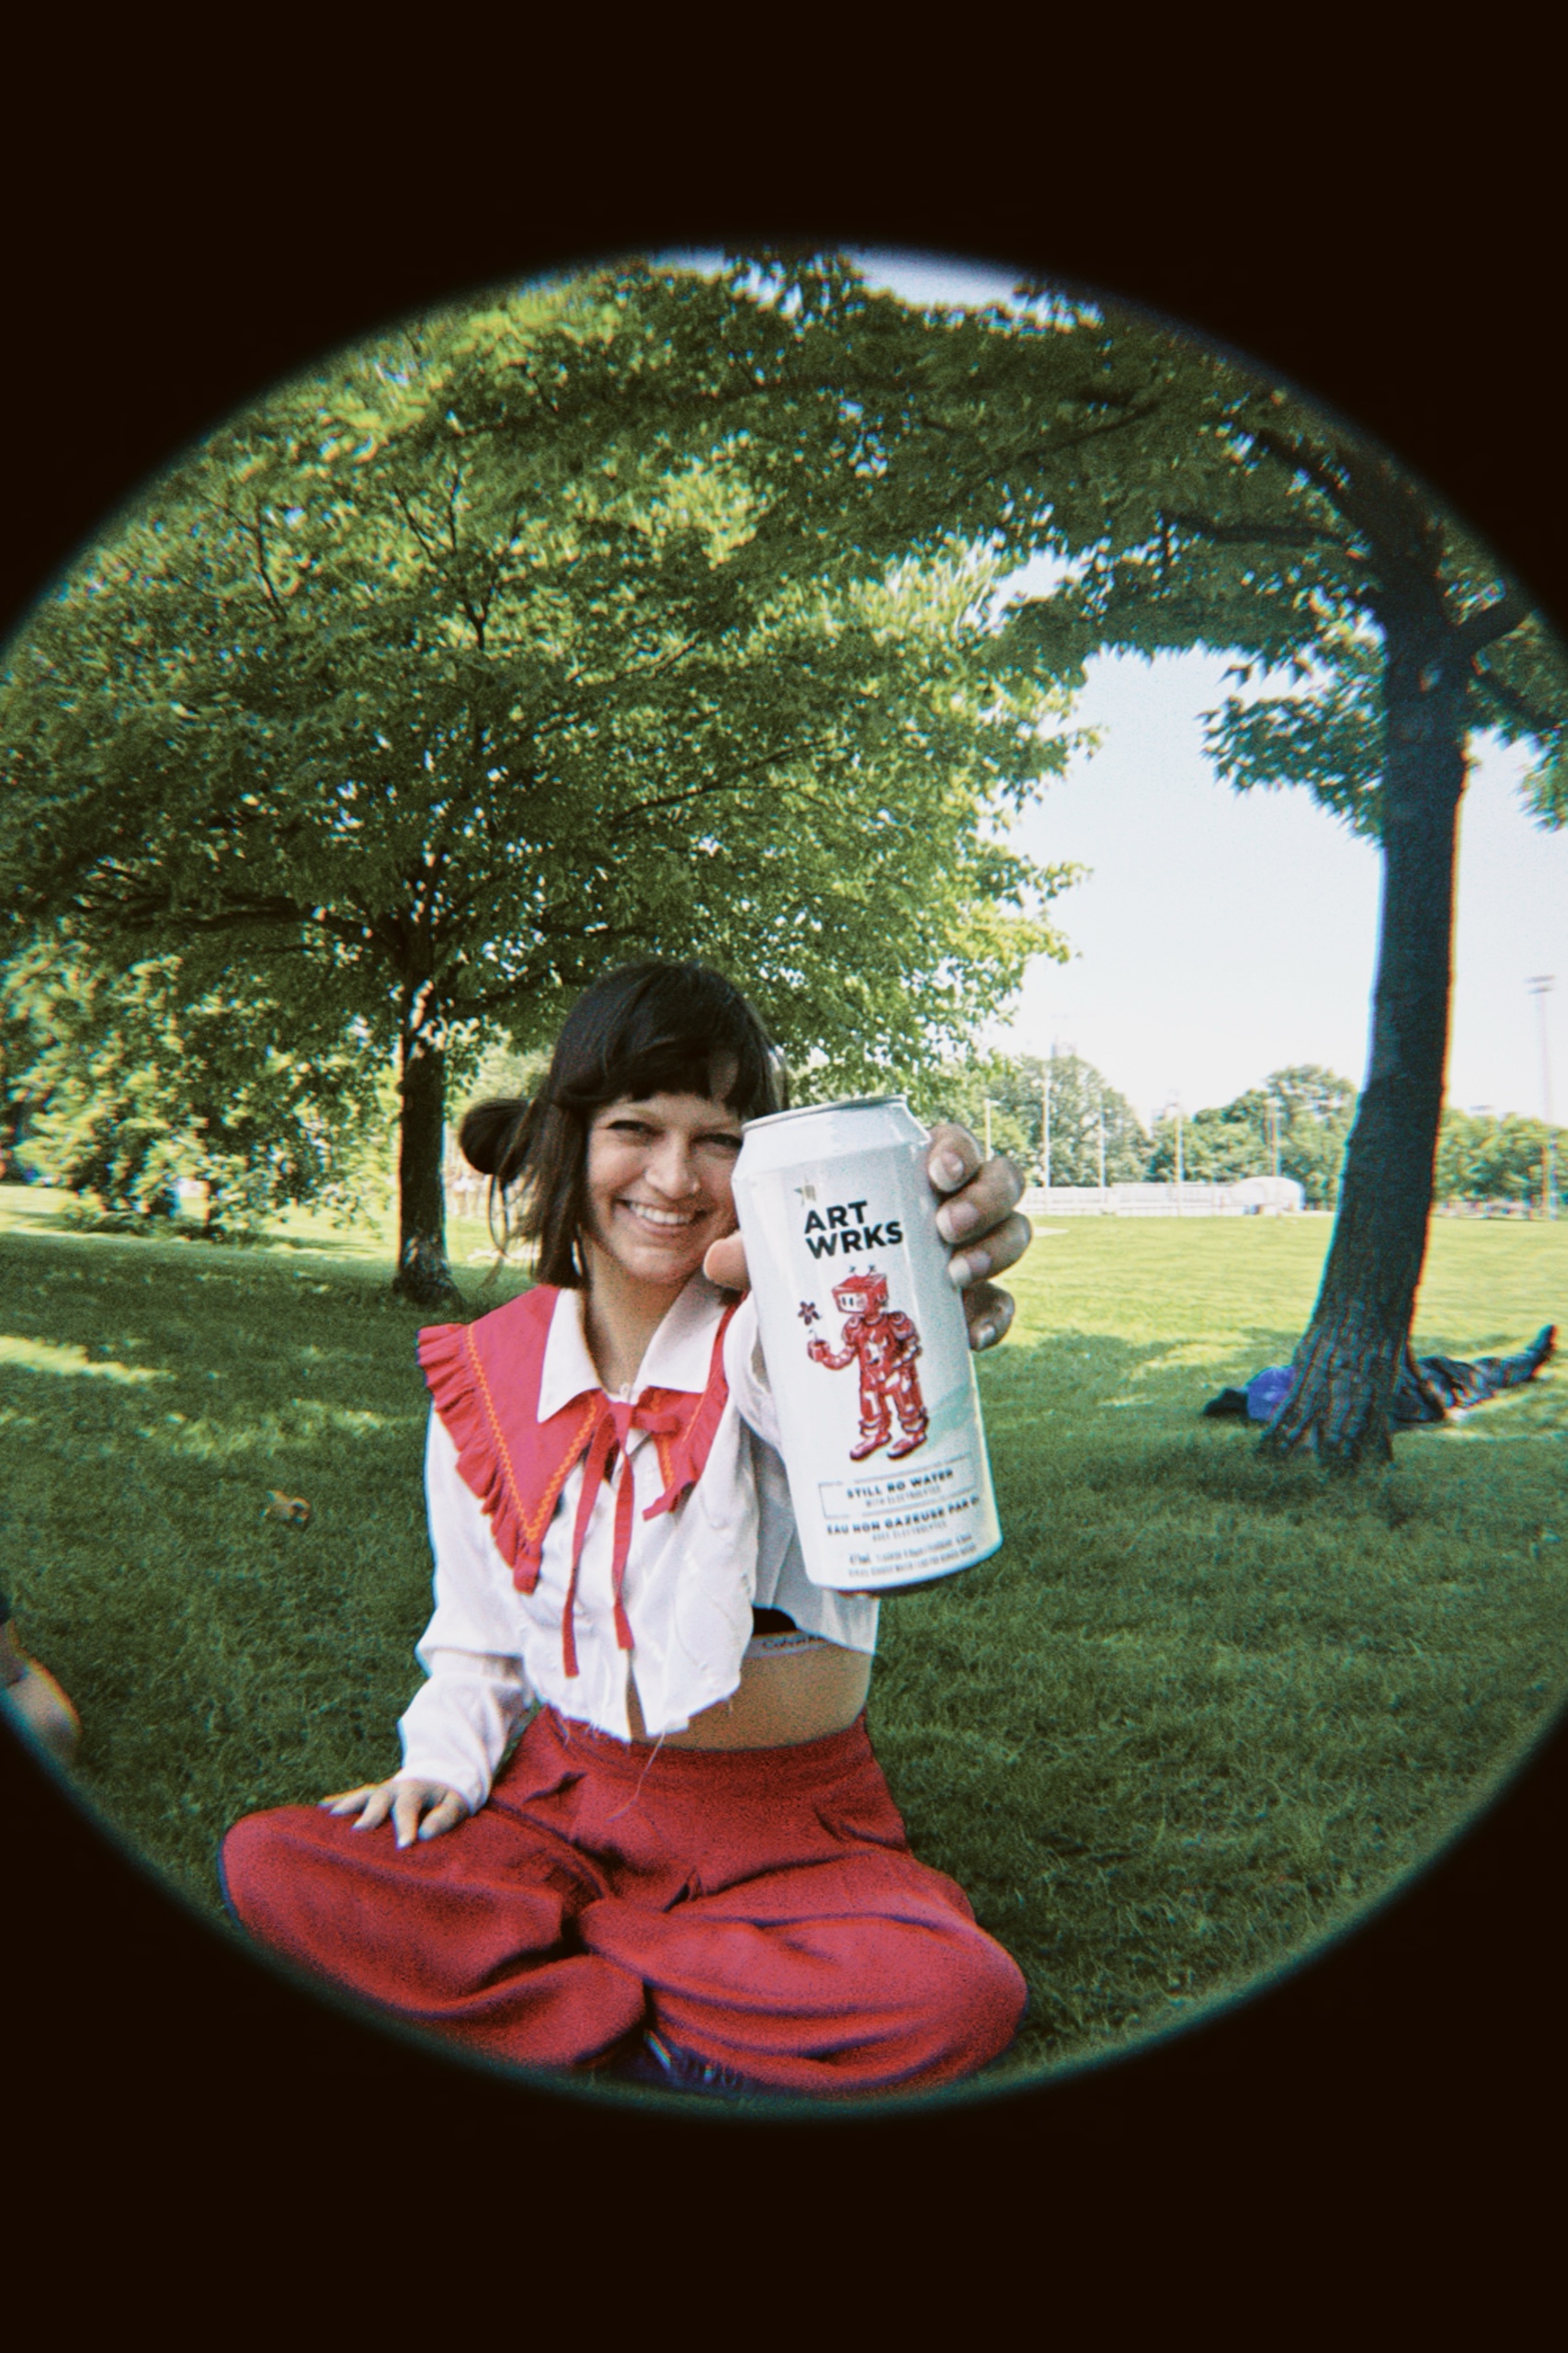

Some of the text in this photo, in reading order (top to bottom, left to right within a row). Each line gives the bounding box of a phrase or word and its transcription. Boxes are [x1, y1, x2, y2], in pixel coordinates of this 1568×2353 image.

[804, 1199, 869, 1234] ART
[805, 1221, 904, 1260] WRKS
[846, 1468, 954, 1499] STILL RO WATER
[826, 1524, 849, 1536] EAU
[853, 1520, 881, 1534] NON
[885, 1506, 945, 1529] GAZEUSE
[948, 1499, 968, 1515] PAR
